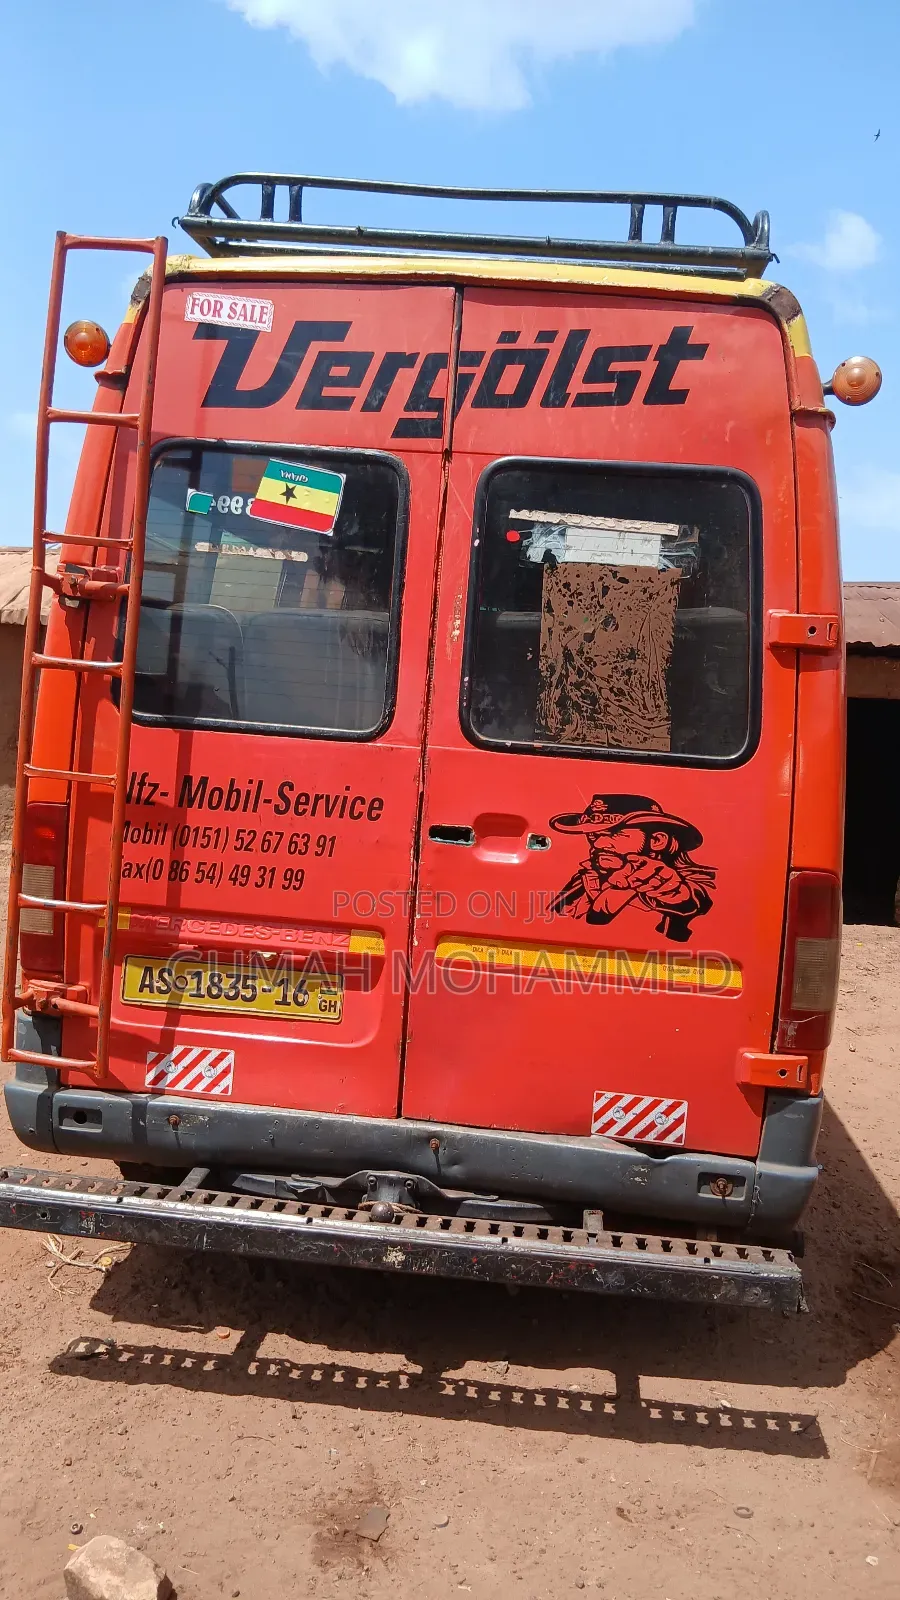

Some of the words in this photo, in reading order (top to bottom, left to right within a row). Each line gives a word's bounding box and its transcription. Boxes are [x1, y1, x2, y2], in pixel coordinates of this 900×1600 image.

[190, 298, 222, 319] FOR
[227, 301, 269, 325] SALE
[192, 321, 710, 439] Vergölst
[178, 775, 385, 822] Mobil-Service
[172, 823, 230, 853] (0151)
[234, 829, 257, 852] 52
[260, 831, 284, 854] 67
[287, 832, 311, 855] 63
[314, 834, 337, 857] 91
[168, 859, 191, 883] 86
[194, 861, 224, 888] 54)
[228, 865, 251, 888] 49
[254, 865, 277, 889] 31
[281, 867, 305, 891] 99
[139, 966, 173, 995] AS
[319, 998, 338, 1013] GH
